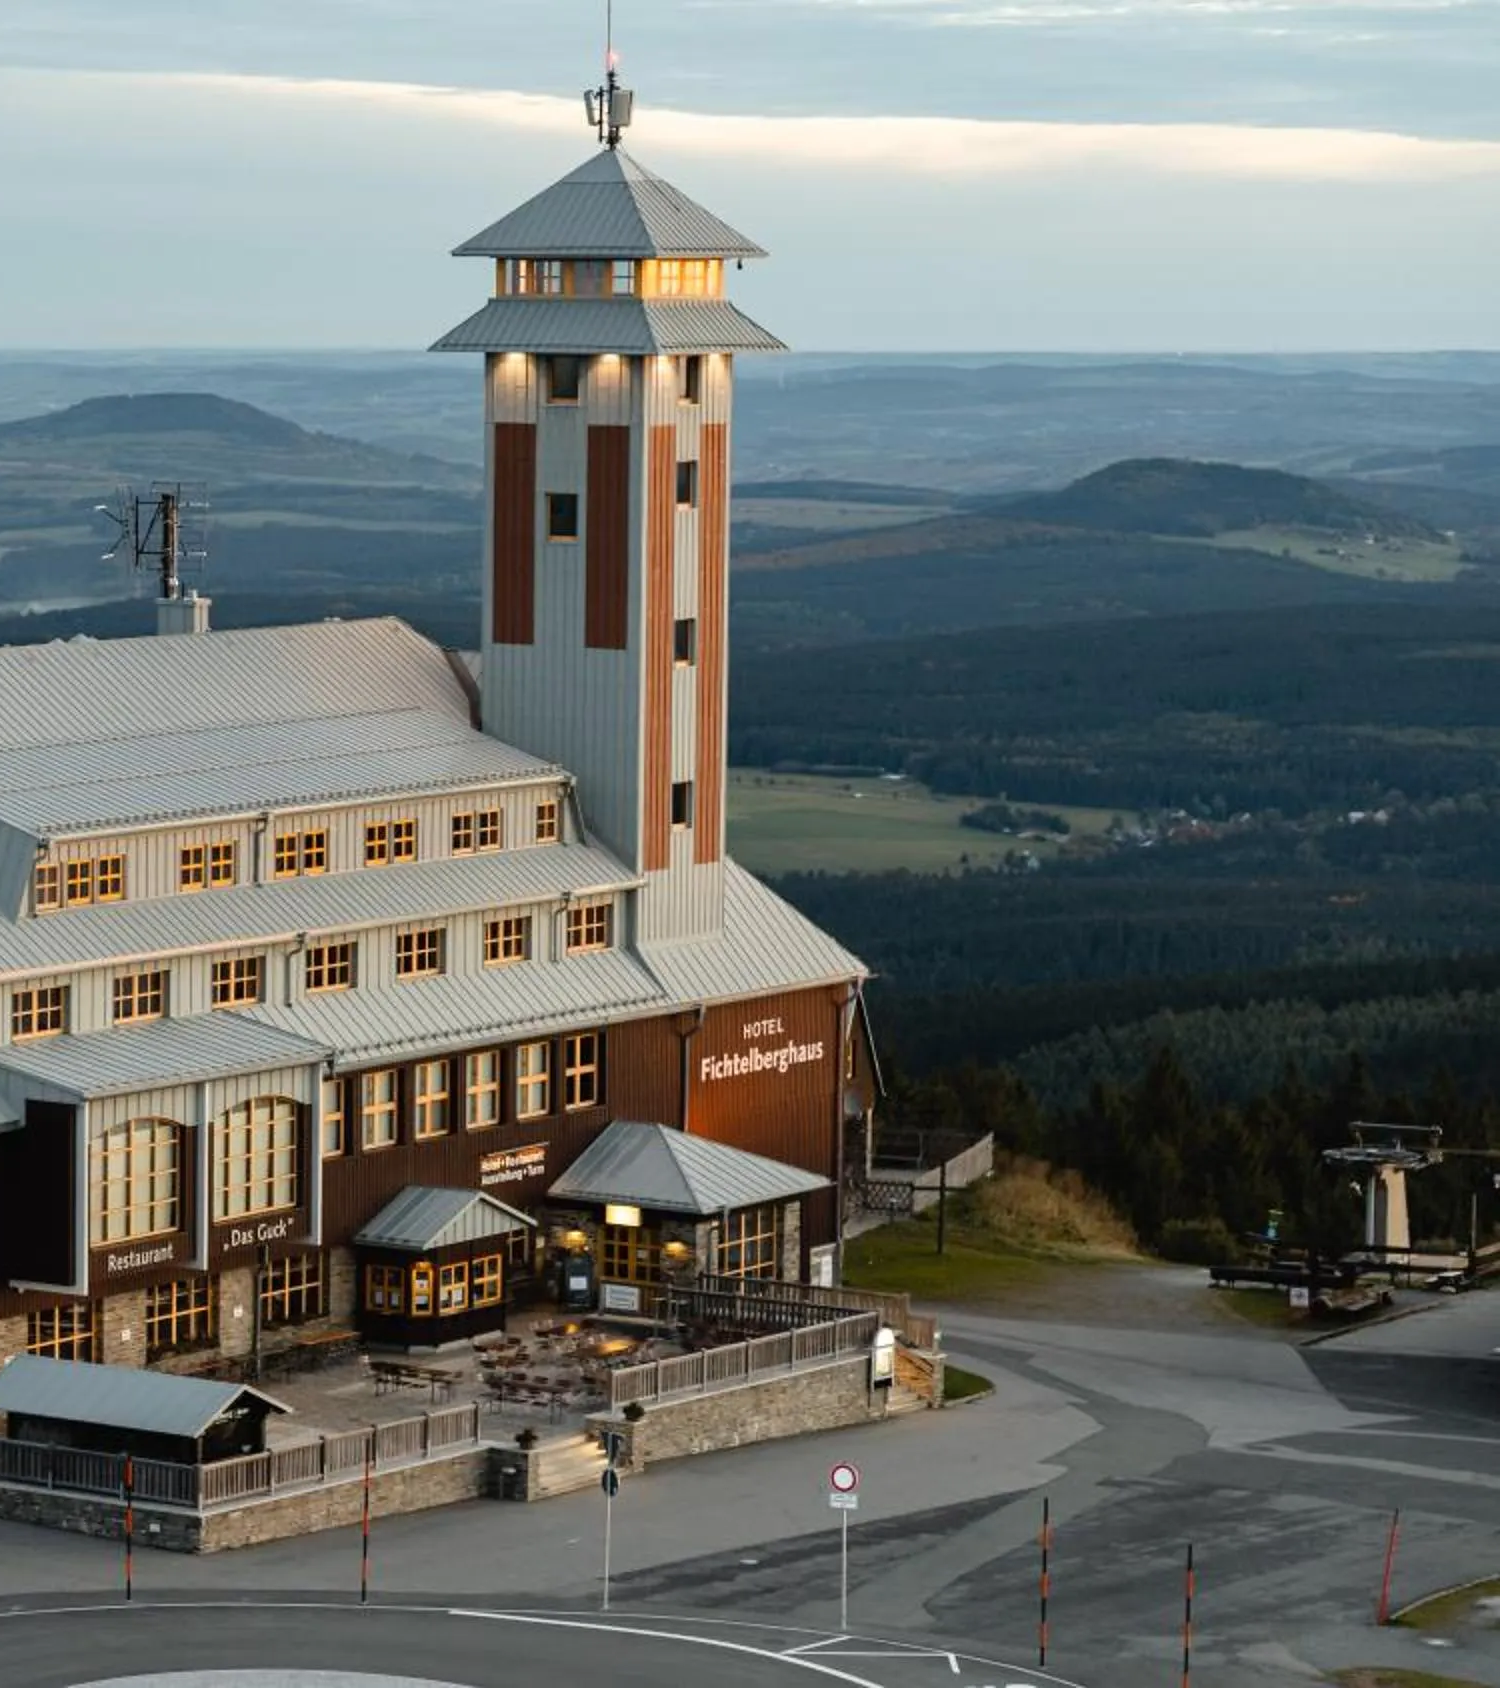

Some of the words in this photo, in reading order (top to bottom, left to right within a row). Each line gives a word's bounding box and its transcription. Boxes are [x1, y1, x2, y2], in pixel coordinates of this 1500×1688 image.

[743, 1017, 785, 1040] HOTEL
[701, 1040, 824, 1083] Fichtelberghaus
[107, 1242, 174, 1272] Restaurant
